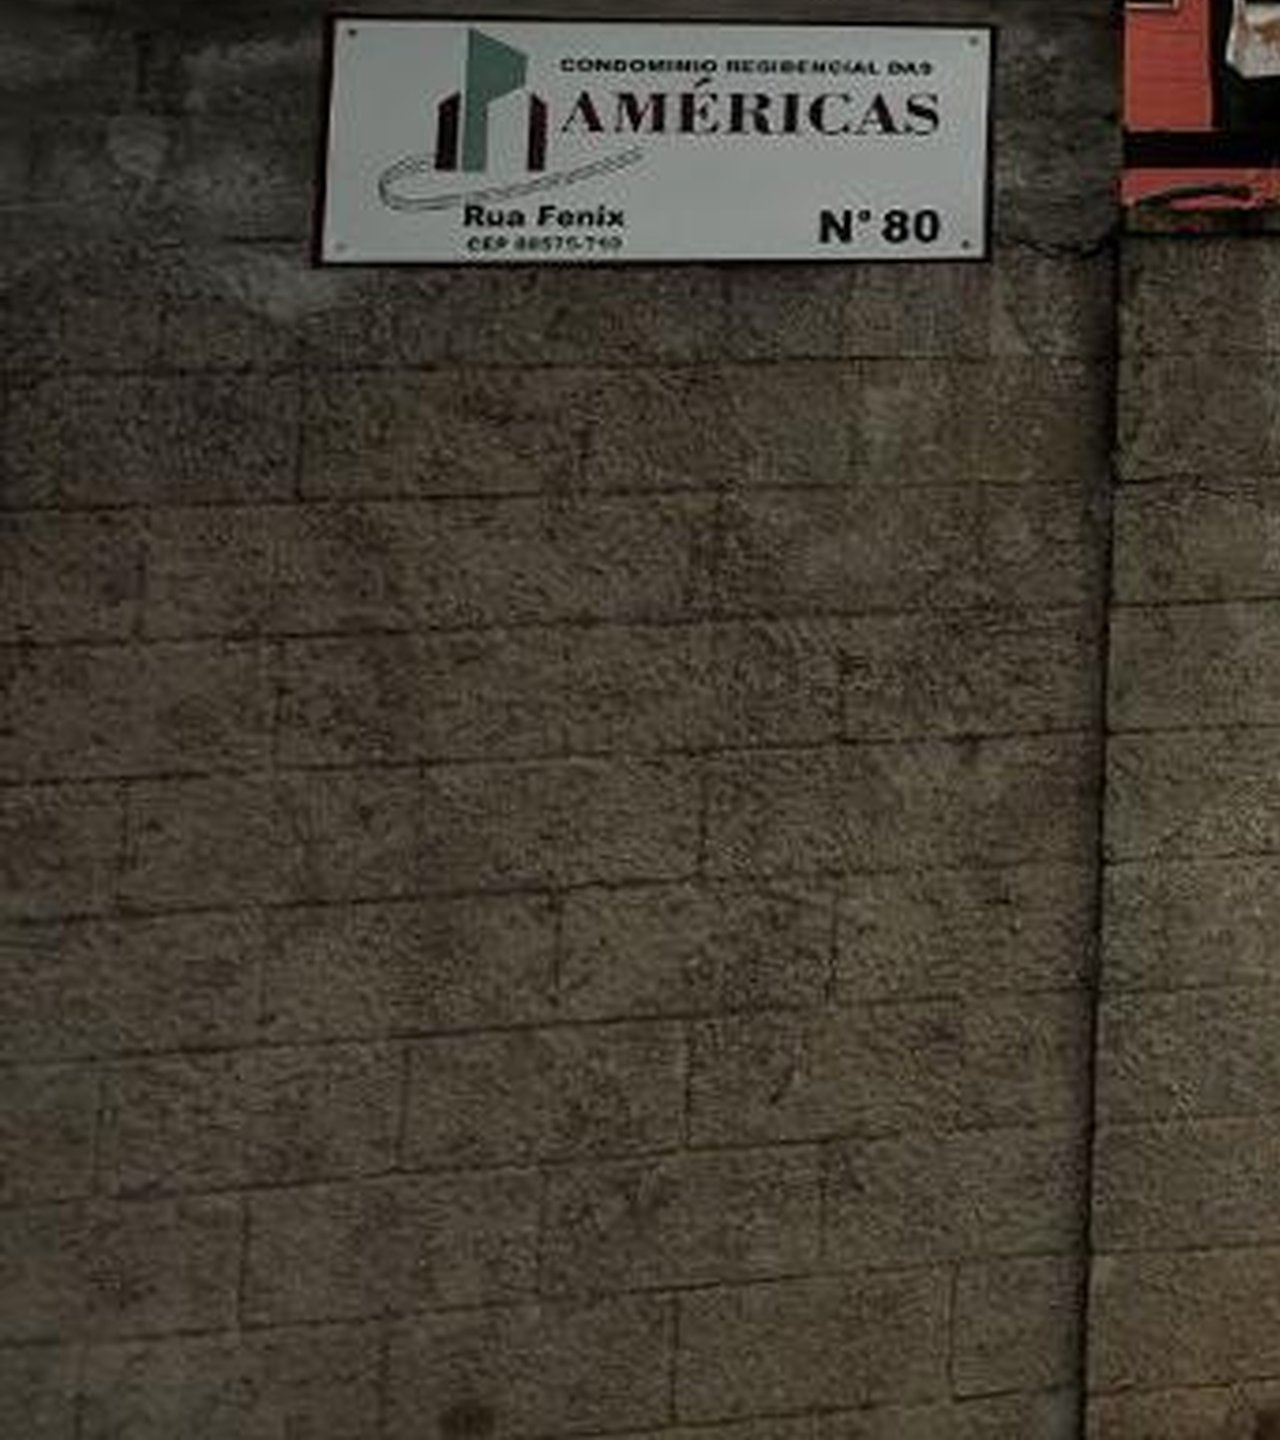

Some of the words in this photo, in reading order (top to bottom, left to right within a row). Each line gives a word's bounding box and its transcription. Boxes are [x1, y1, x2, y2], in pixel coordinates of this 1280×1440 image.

[887, 60, 934, 76] DAS
[560, 76, 940, 136] AMÉRICAS
[463, 204, 526, 227] Rua
[536, 203, 625, 227] Fenix
[880, 208, 940, 244] 80
